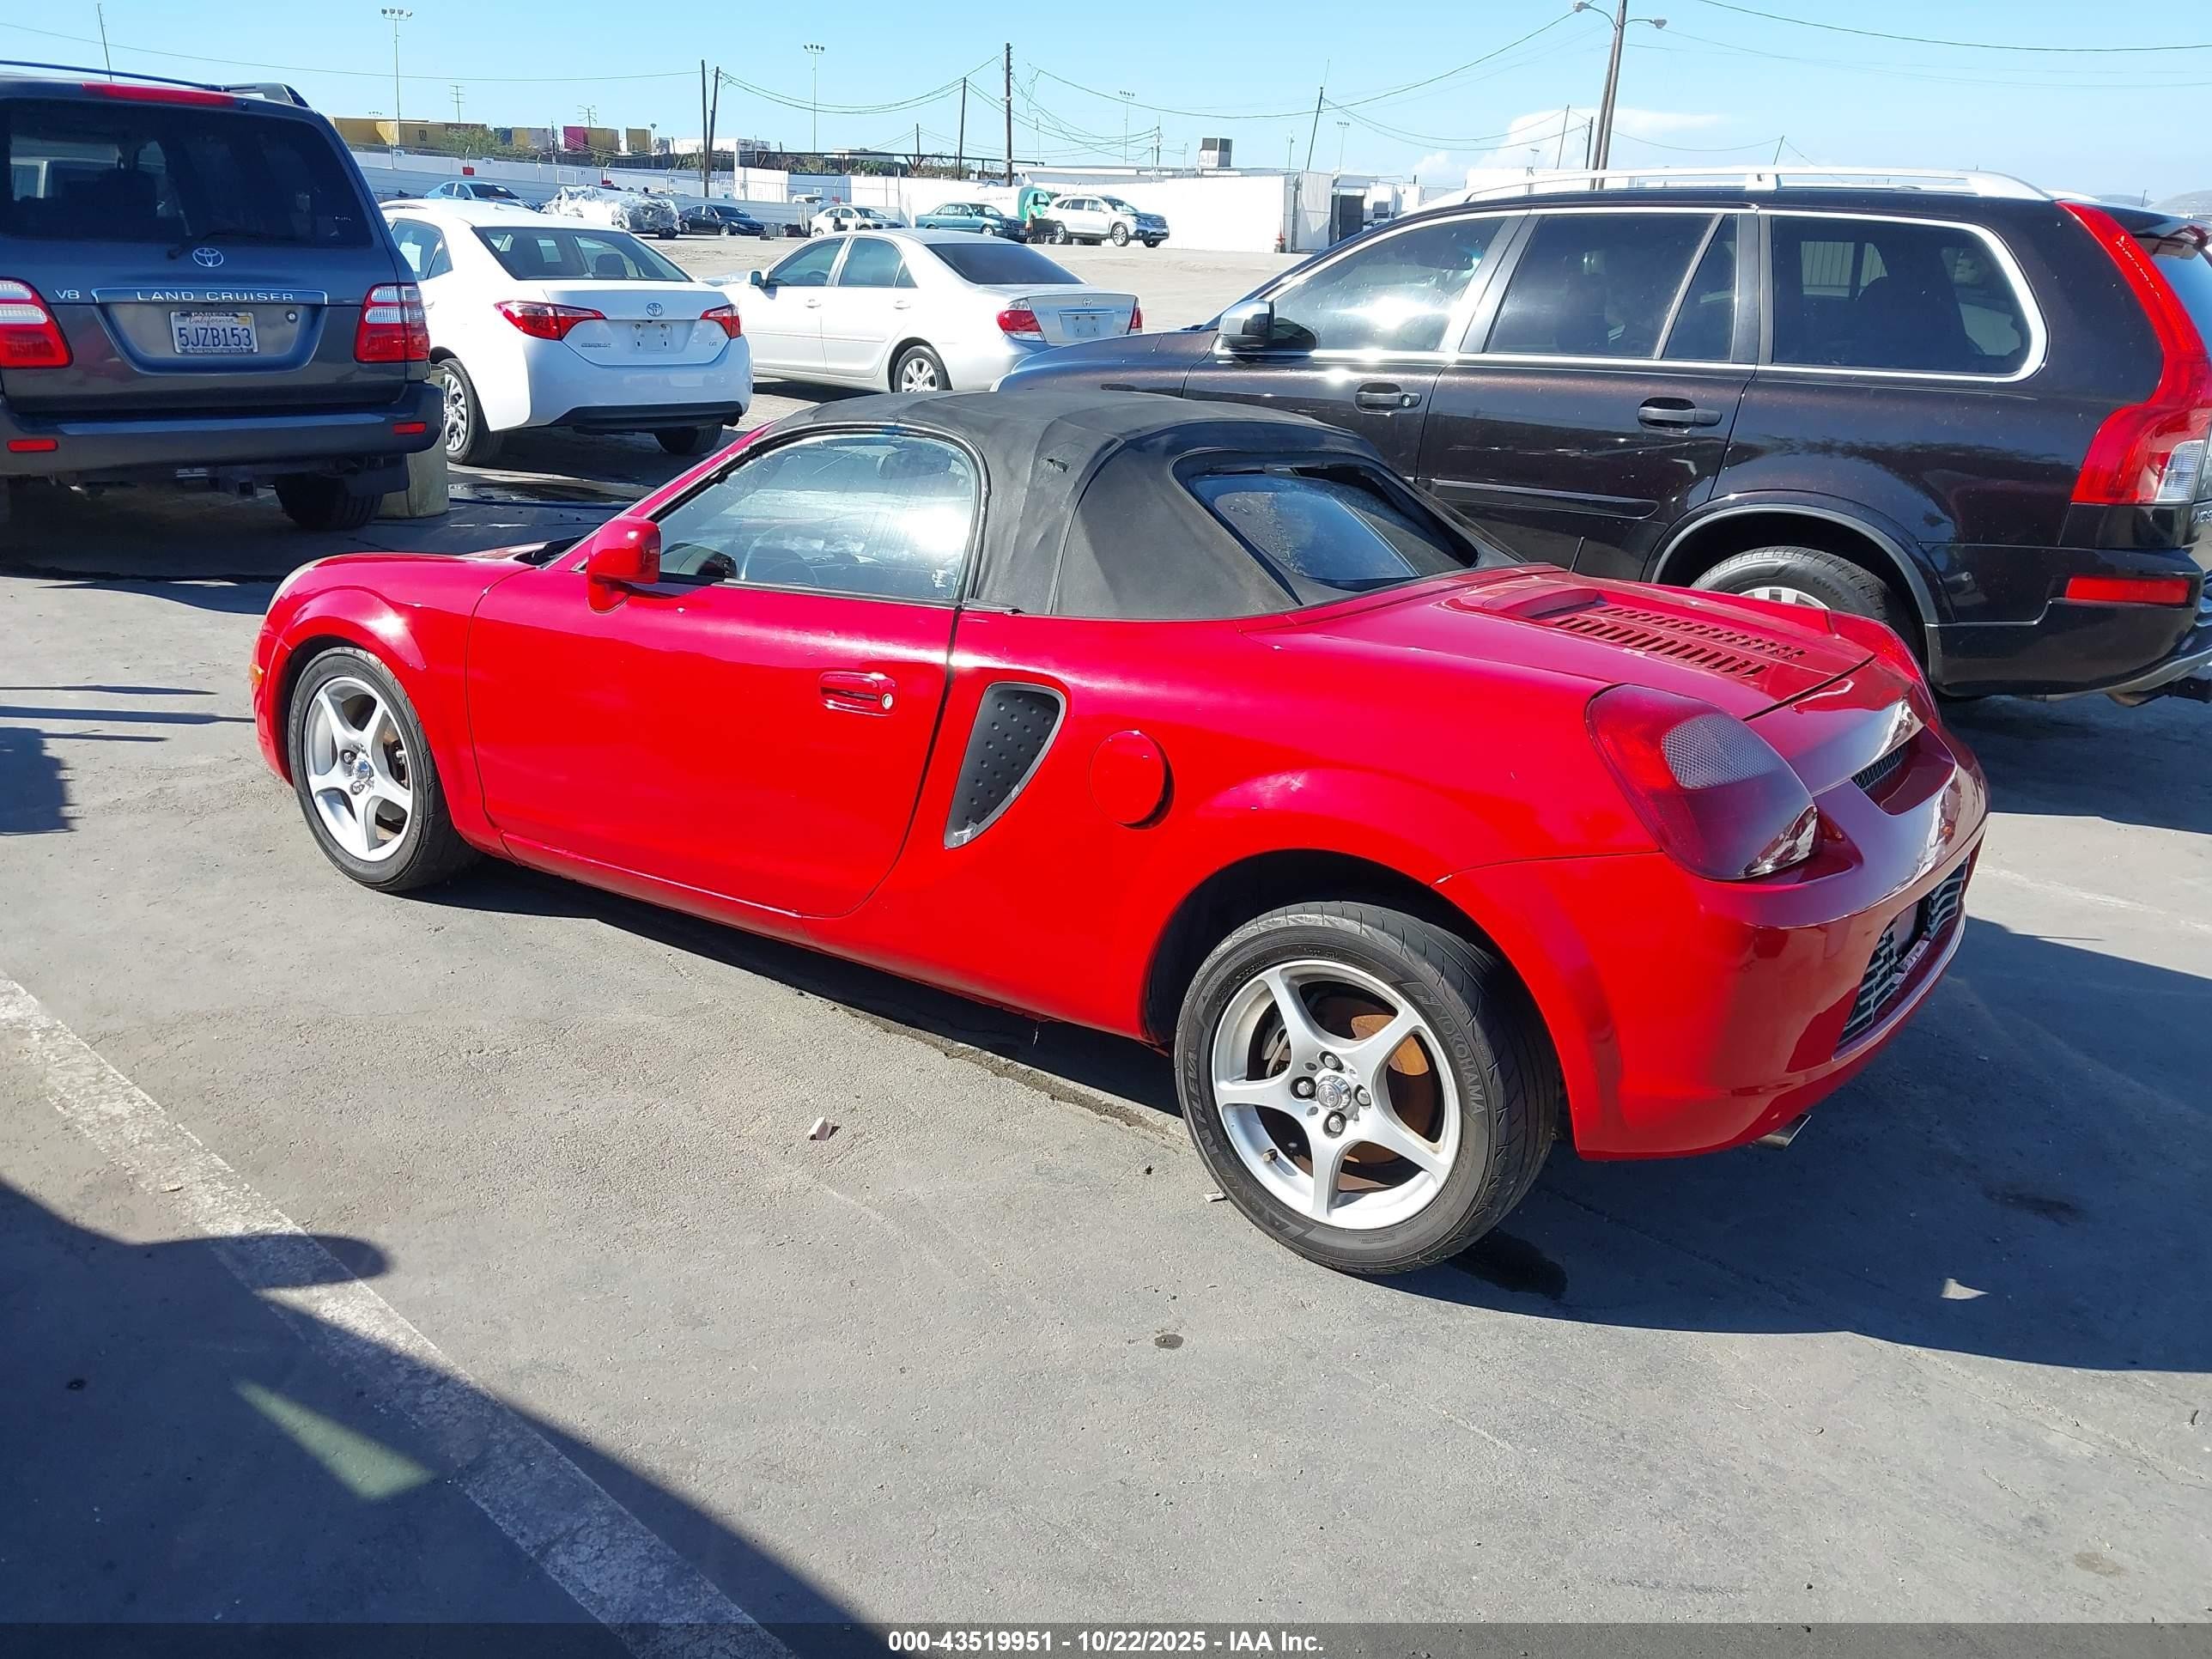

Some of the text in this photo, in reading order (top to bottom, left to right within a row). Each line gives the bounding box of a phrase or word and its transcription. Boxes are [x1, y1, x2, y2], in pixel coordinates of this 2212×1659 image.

[55, 289, 80, 300] V8
[137, 291, 295, 301] LAND CRUISER
[178, 327, 252, 347] 5JZB153
[1435, 1015, 1486, 1115] YOKOHAMA
